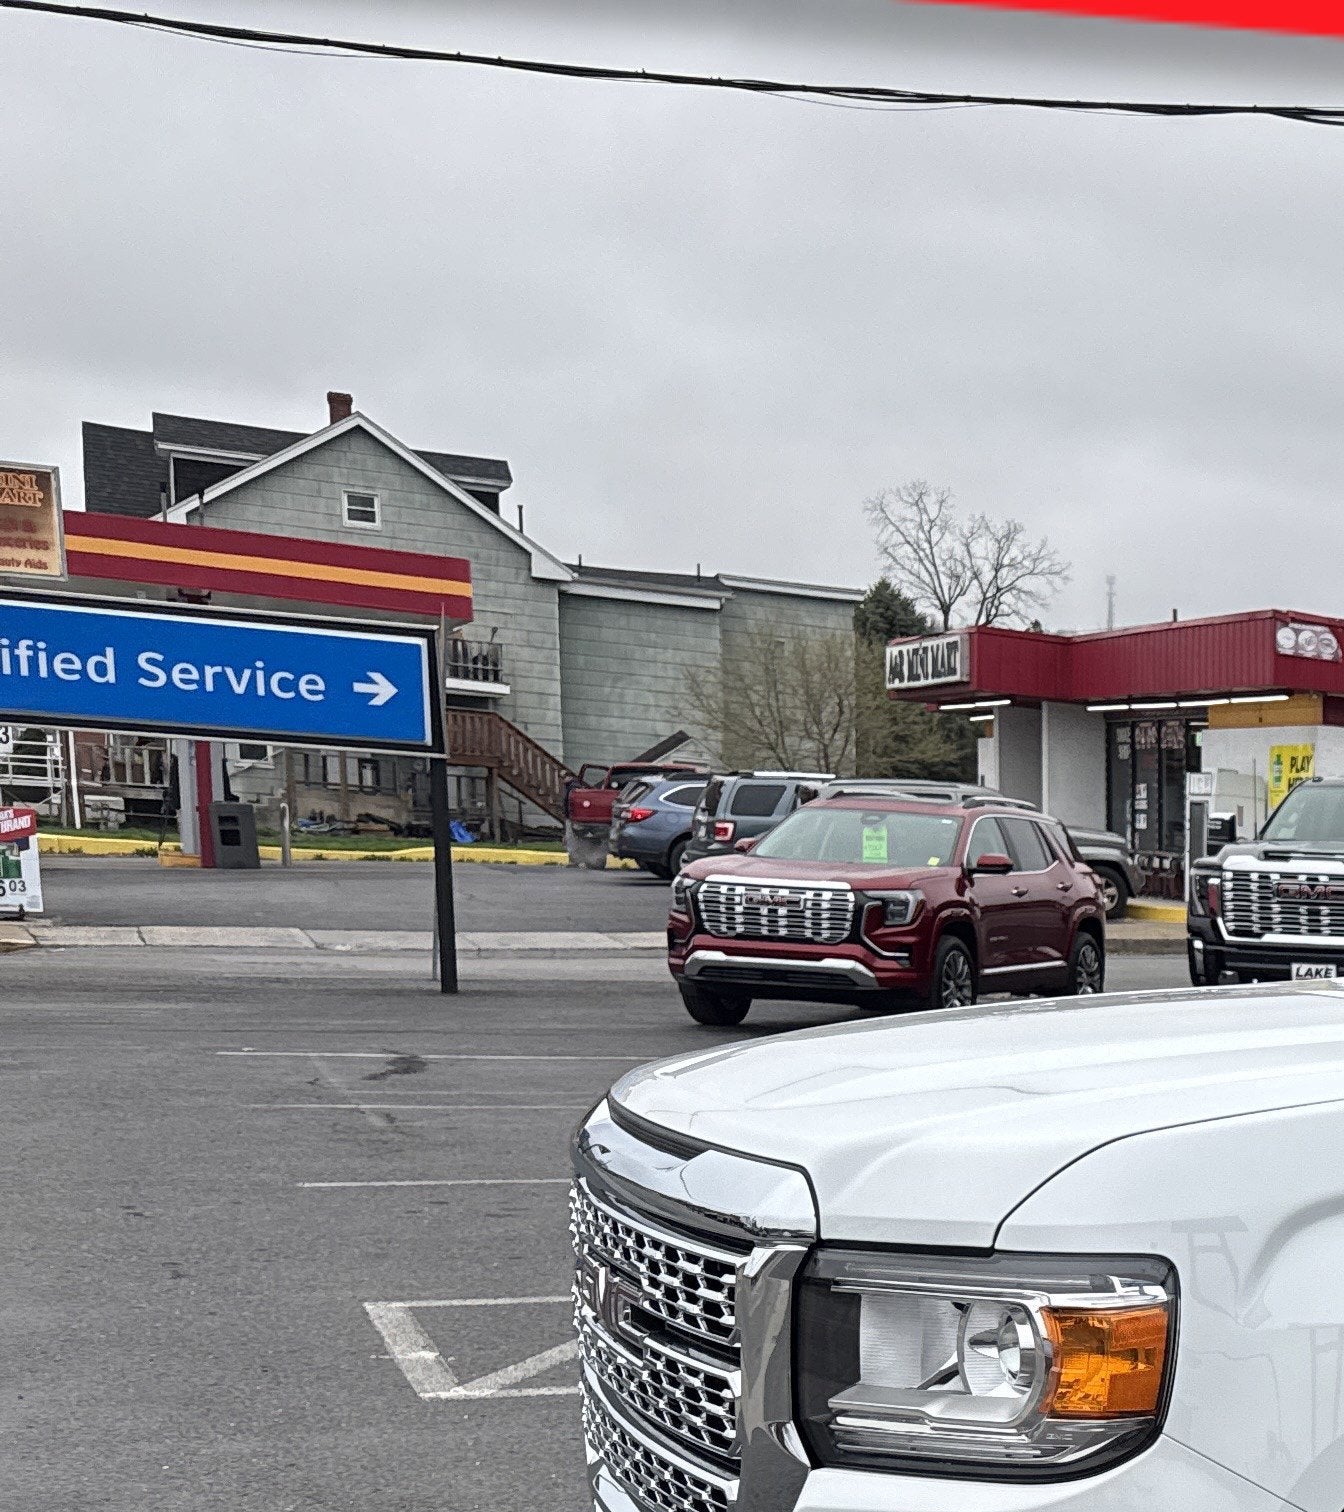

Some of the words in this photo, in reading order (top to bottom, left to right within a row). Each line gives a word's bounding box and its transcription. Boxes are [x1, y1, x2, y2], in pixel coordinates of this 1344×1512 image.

[137, 651, 326, 701] Service
[1290, 755, 1312, 773] PLAY
[1296, 966, 1333, 979] LAKE
